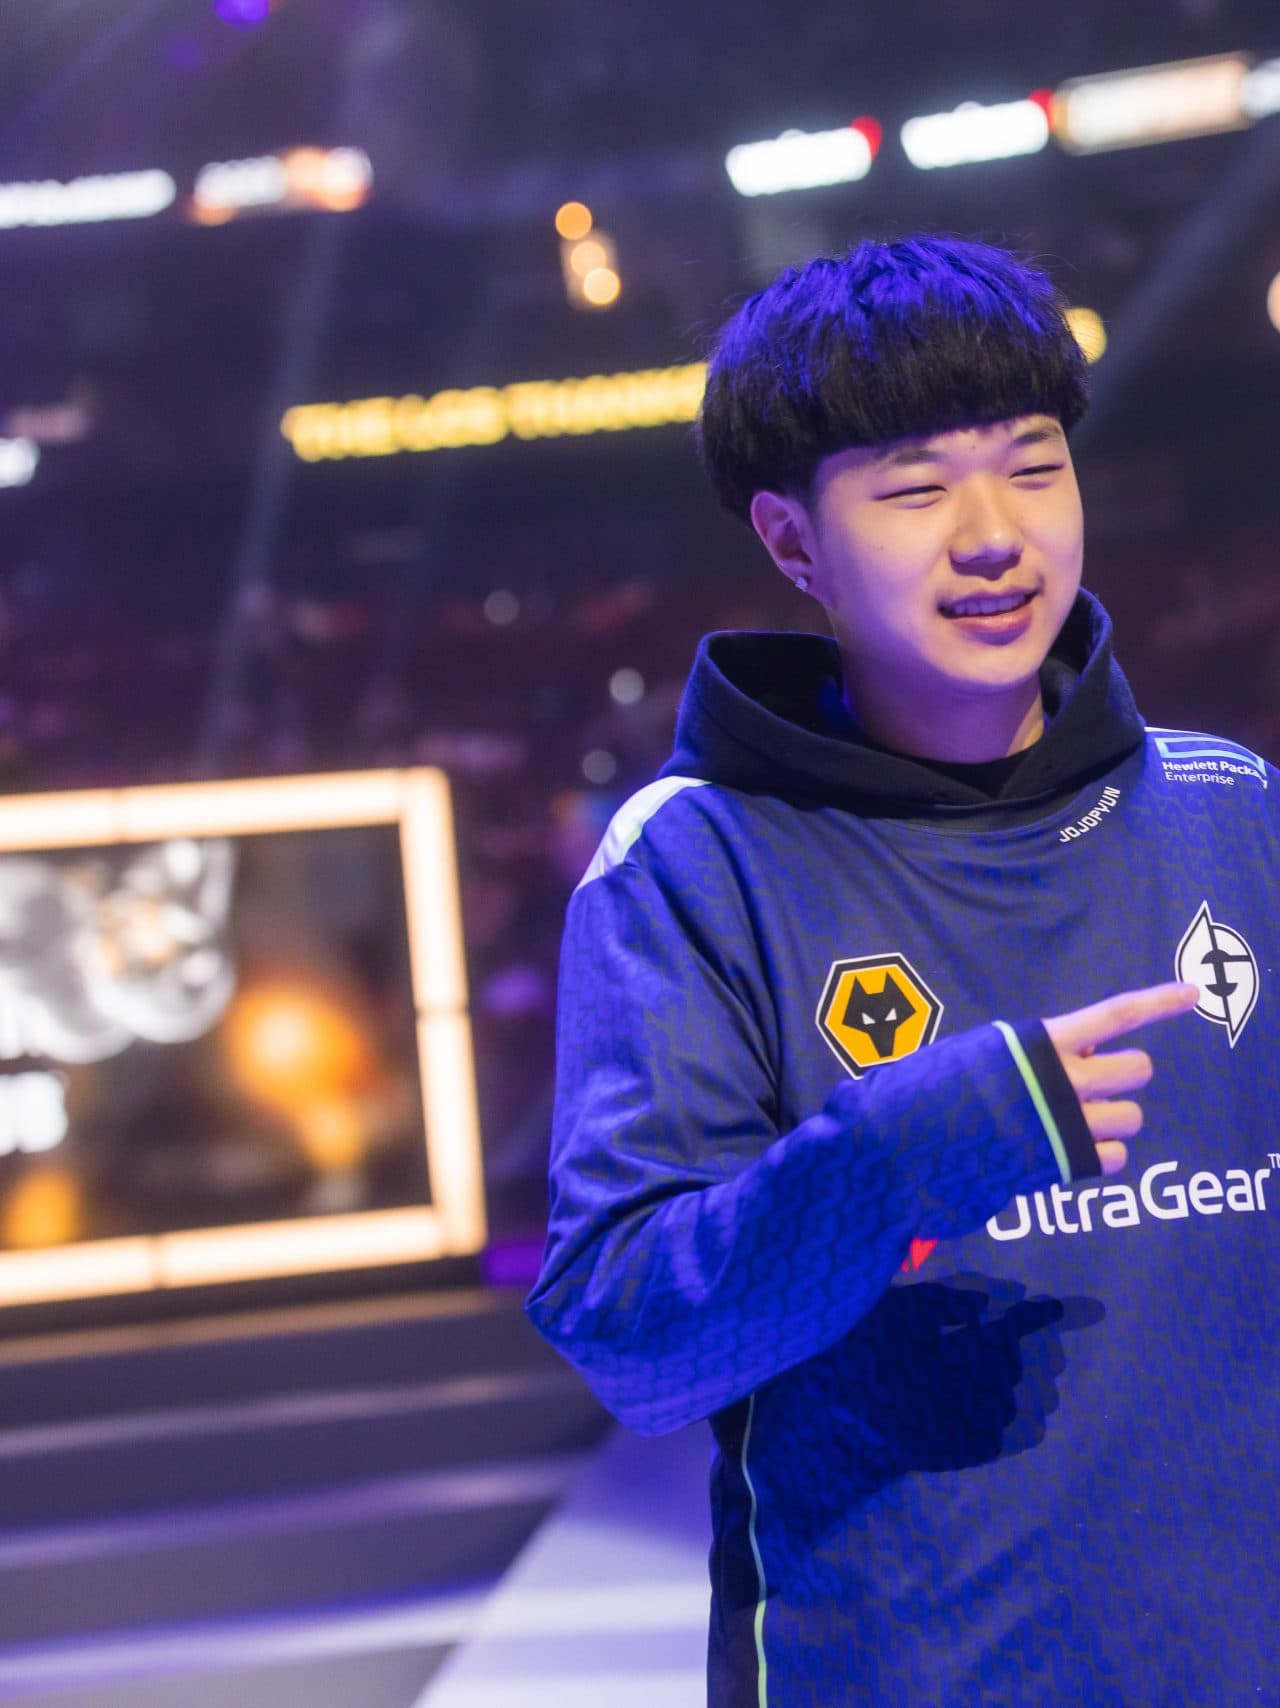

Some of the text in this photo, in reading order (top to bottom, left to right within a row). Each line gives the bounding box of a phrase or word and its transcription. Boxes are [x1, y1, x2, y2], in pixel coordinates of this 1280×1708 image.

[1161, 760, 1219, 771] Hewlett
[1164, 771, 1235, 786] Enterprise
[1059, 786, 1121, 843] JOJOPYUN
